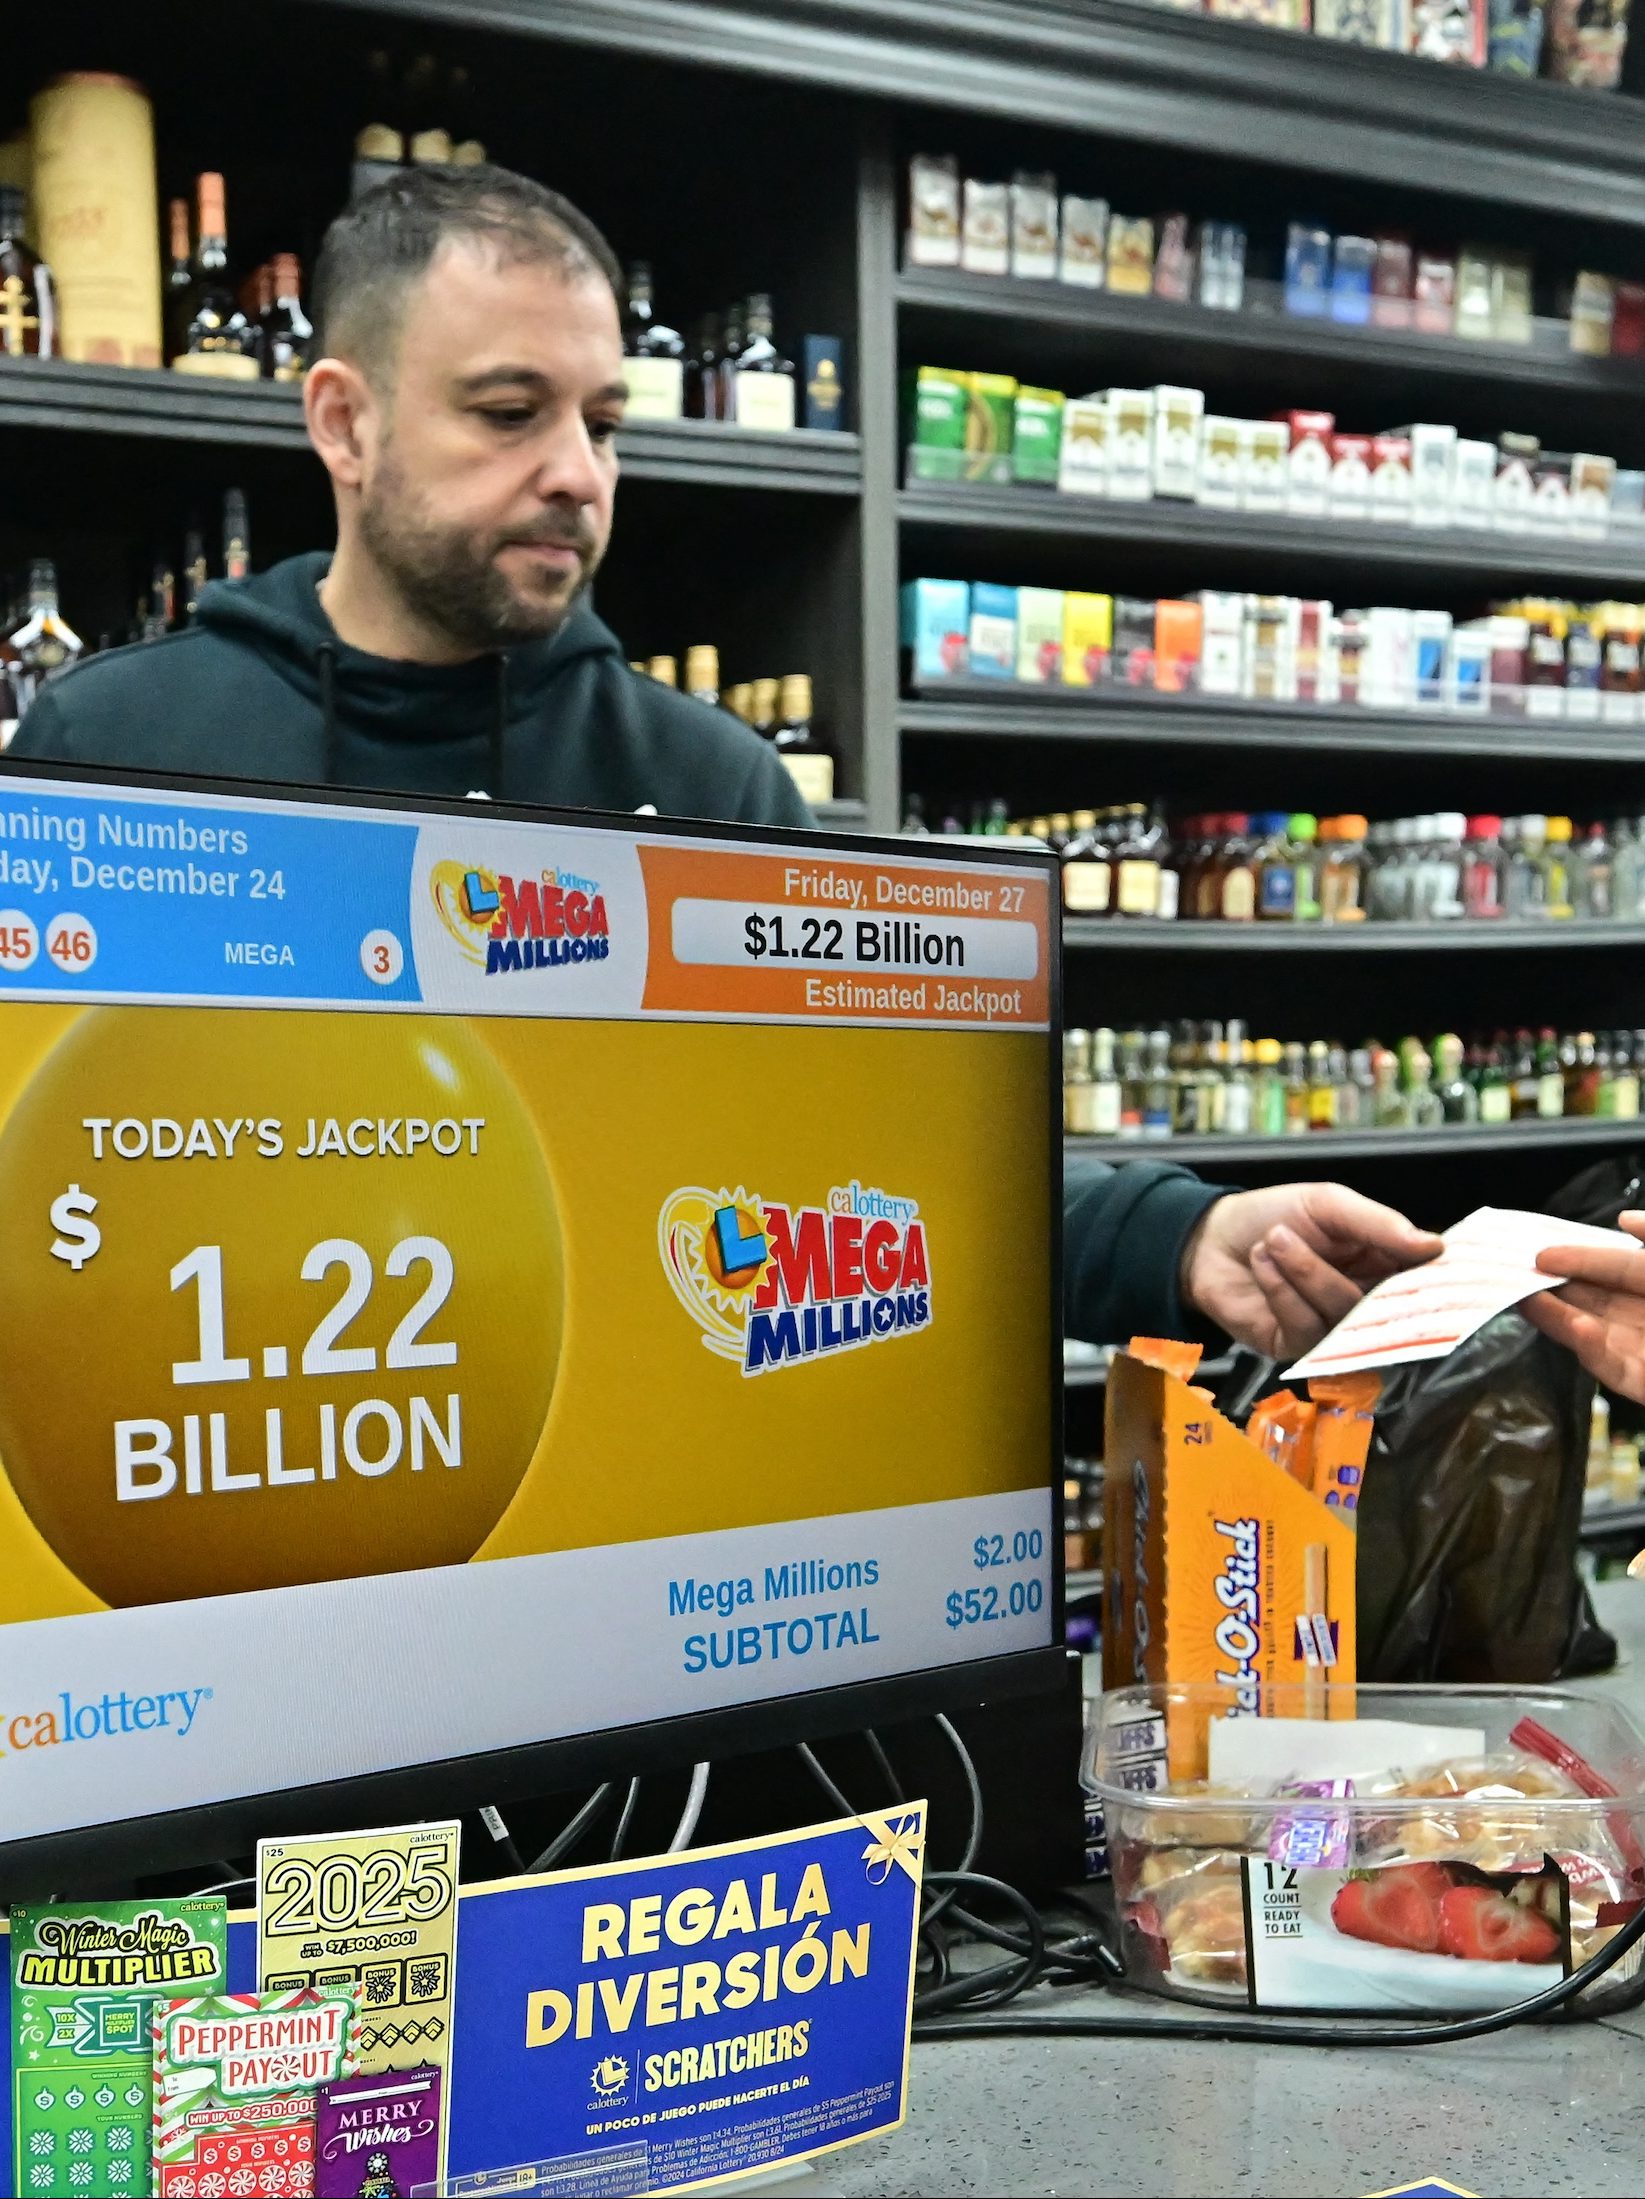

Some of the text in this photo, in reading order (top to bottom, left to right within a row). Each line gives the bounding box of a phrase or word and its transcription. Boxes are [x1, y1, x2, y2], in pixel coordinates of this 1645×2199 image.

[98, 813, 249, 855] Numbers
[71, 856, 238, 898] December
[249, 869, 286, 900] 24
[541, 866, 599, 897] calottery
[784, 868, 1025, 914] Friday, December 27
[489, 875, 609, 939] MEGA
[52, 930, 91, 962] 46
[224, 941, 295, 967] MEGA
[486, 937, 609, 976] MILLIONS
[744, 912, 965, 968] $1.22 Billion
[373, 946, 390, 975] 3
[806, 978, 1022, 1021] Estimated Jackpot
[296, 1118, 486, 1156] JACKPOT
[831, 1185, 915, 1226] calottery
[49, 1184, 101, 1270] $
[753, 1206, 929, 1311] MEGA
[169, 1235, 458, 1385] 1.22
[747, 1292, 930, 1370] MILLIONS
[113, 1393, 462, 1502] BILLION
[1184, 1421, 1203, 1446] 24
[973, 1528, 1043, 1572] $2.00
[668, 1558, 879, 1618] Mega Millions
[945, 1578, 1043, 1630] $52.00
[683, 1606, 880, 1675] SUBTOTAL
[266, 1848, 284, 1858] $25
[265, 1843, 451, 1938] 2025
[1263, 1862, 1299, 1890] 12
[580, 1862, 831, 1965] REGALA
[1263, 1893, 1300, 1904] COUNT
[1264, 1911, 1300, 1922] READY
[42, 1917, 188, 1955] Winter Magic
[327, 1931, 417, 1955] $7,500,000!
[1265, 1923, 1301, 1934] TO EAT
[23, 1949, 216, 1985] MULTIPLIER
[274, 1980, 303, 1990] BONUS
[321, 1974, 349, 1985] BONUS
[367, 1969, 395, 1979] BONUS
[412, 1962, 440, 1973] BONUS
[525, 1920, 872, 2049] DIVERSIÓN
[57, 2013, 75, 2022] 10X
[58, 2029, 74, 2038] 2X
[106, 2025, 134, 2034] SPOT
[179, 2009, 340, 2056] PEPPERMINT
[229, 2050, 333, 2088] PAYOUT
[644, 2019, 810, 2093] SCRATCHERS
[190, 2113, 209, 2125] WIN
[212, 2111, 226, 2122] UP
[228, 2111, 241, 2120] TO
[338, 2100, 422, 2130] MERRY
[586, 2096, 629, 2111] calottery
[586, 2075, 810, 2136] UN POCO DE JUEGO PUEDE HACERTE EL DÍA
[323, 2119, 434, 2160] Wishes
[541, 2156, 596, 2175] Probabilidades
[652, 2142, 673, 2154] Merry
[674, 2136, 698, 2149] Wishes
[699, 2133, 712, 2142] son
[733, 2115, 781, 2134] Probabilidades
[782, 2107, 812, 2124] generales
[812, 2104, 821, 2113] de
[830, 2091, 864, 2108] Peppermint
[653, 2153, 663, 2162] de
[664, 2151, 676, 2162] $10
[676, 2147, 699, 2159] Winter
[700, 2141, 719, 2153] Magic
[721, 2134, 752, 2150] Multiplier
[753, 2130, 765, 2140] son
[783, 2113, 828, 2132] Probabilidades
[828, 2105, 858, 2120] generales
[610, 2173, 633, 2185] Ayuda
[651, 2160, 689, 2175] Problemas
[689, 2158, 699, 2167] de
[782, 2131, 801, 2144] Debes
[801, 2126, 818, 2138] tener
[601, 2182, 633, 2196] reclamar
[686, 2163, 718, 2178] California
